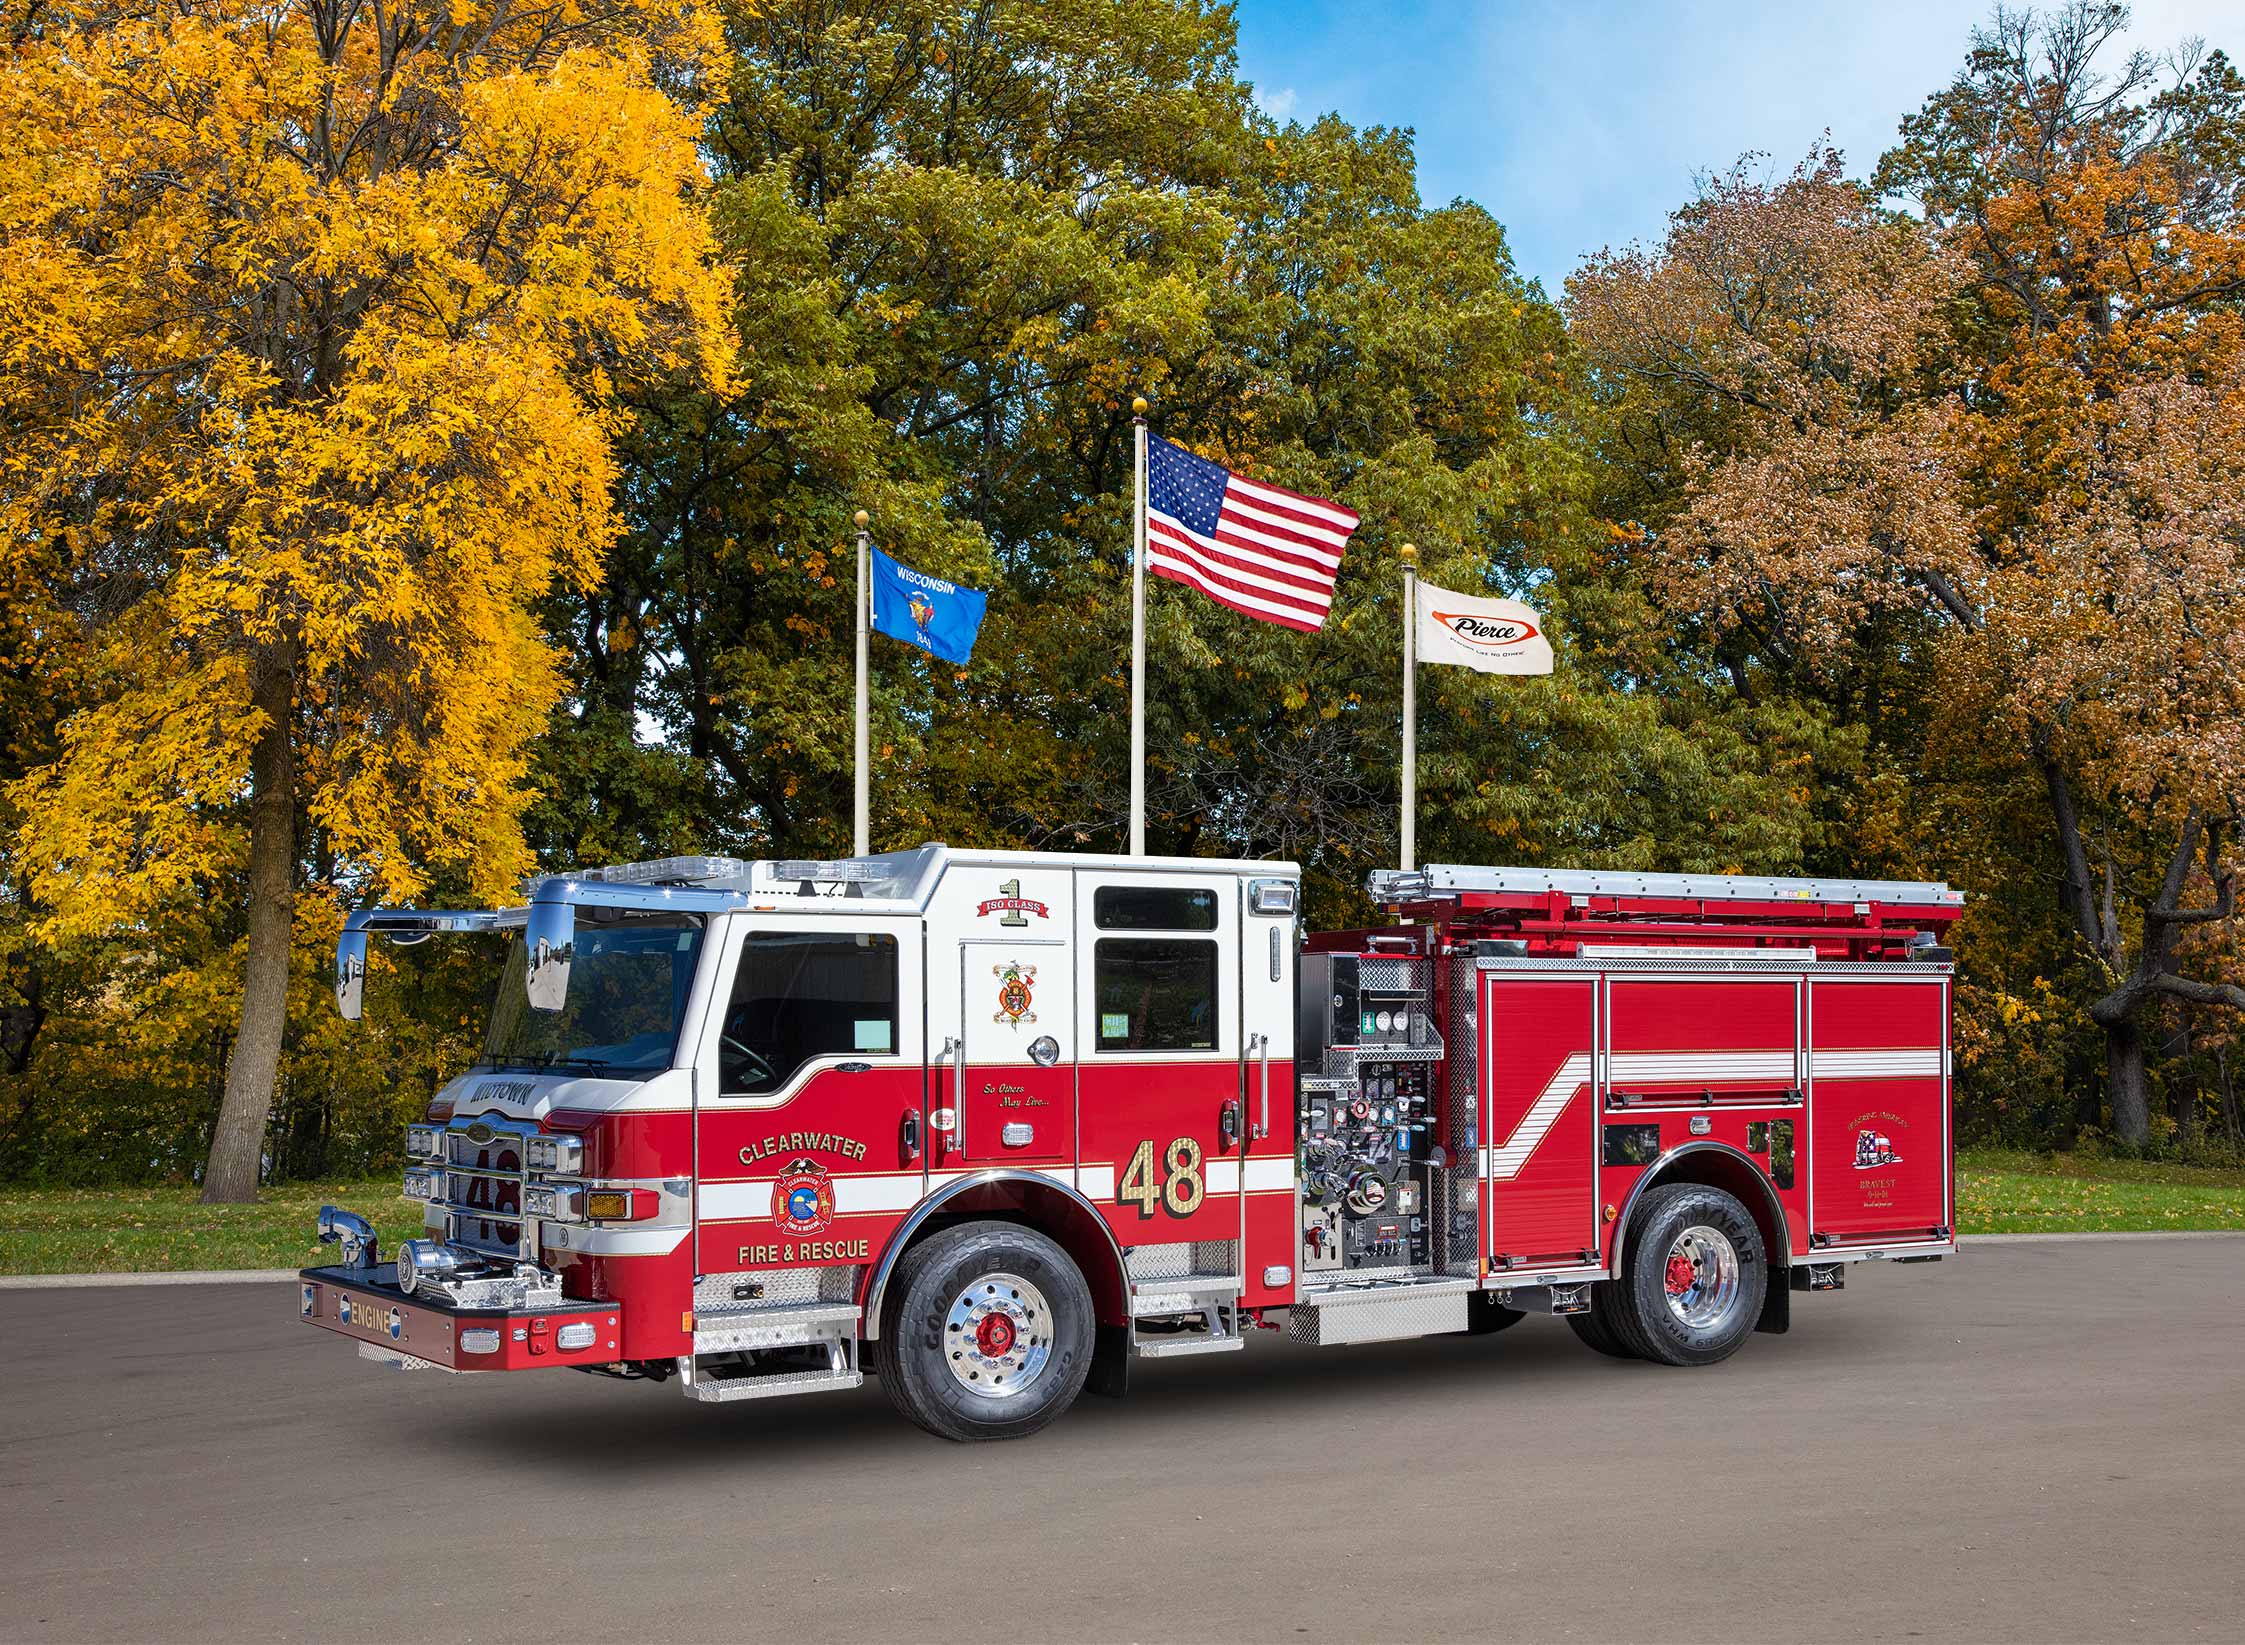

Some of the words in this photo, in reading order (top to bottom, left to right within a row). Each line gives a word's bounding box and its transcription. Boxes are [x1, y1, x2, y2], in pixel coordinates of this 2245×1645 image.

[897, 566, 956, 595] WISCONSIN
[1455, 617, 1516, 639] Pierce
[985, 899, 1005, 911] ISO
[1007, 899, 1041, 912] CLASS
[982, 1083, 995, 1095] So
[998, 1083, 1025, 1094] Others
[999, 1096, 1021, 1109] May
[738, 1131, 868, 1167] CLEARWATER
[788, 1176, 819, 1188] CLEARWATER
[1116, 1136, 1205, 1221] 48
[1859, 1178, 1896, 1190] BRAVEST
[466, 1149, 521, 1246] 48
[786, 1221, 798, 1231] FIRE
[738, 1244, 779, 1265] FIRE
[782, 1242, 795, 1262] &
[799, 1239, 869, 1261] RESCUE
[351, 1301, 390, 1334] ENGINE
